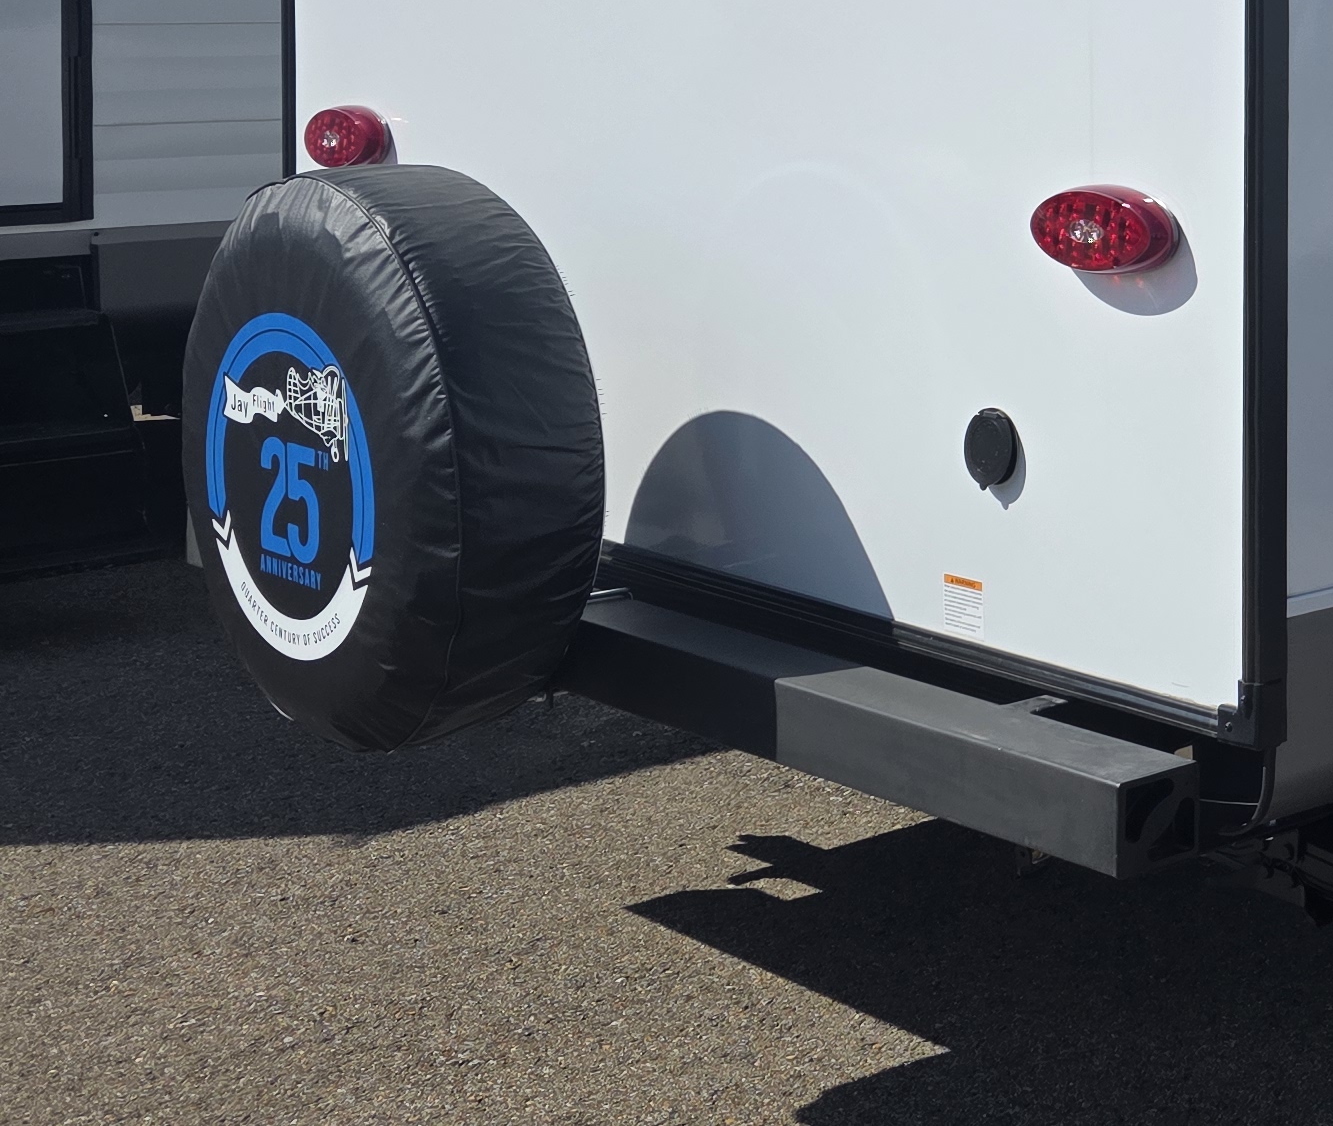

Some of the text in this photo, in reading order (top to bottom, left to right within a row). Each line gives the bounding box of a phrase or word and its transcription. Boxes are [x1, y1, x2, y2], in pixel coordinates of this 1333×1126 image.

[231, 393, 275, 419] Jay Flight
[260, 436, 329, 564] 25 TH
[260, 553, 322, 591] ANNIVERSARY
[240, 581, 341, 646] QUARTER CENTURY OF SUCCESS
